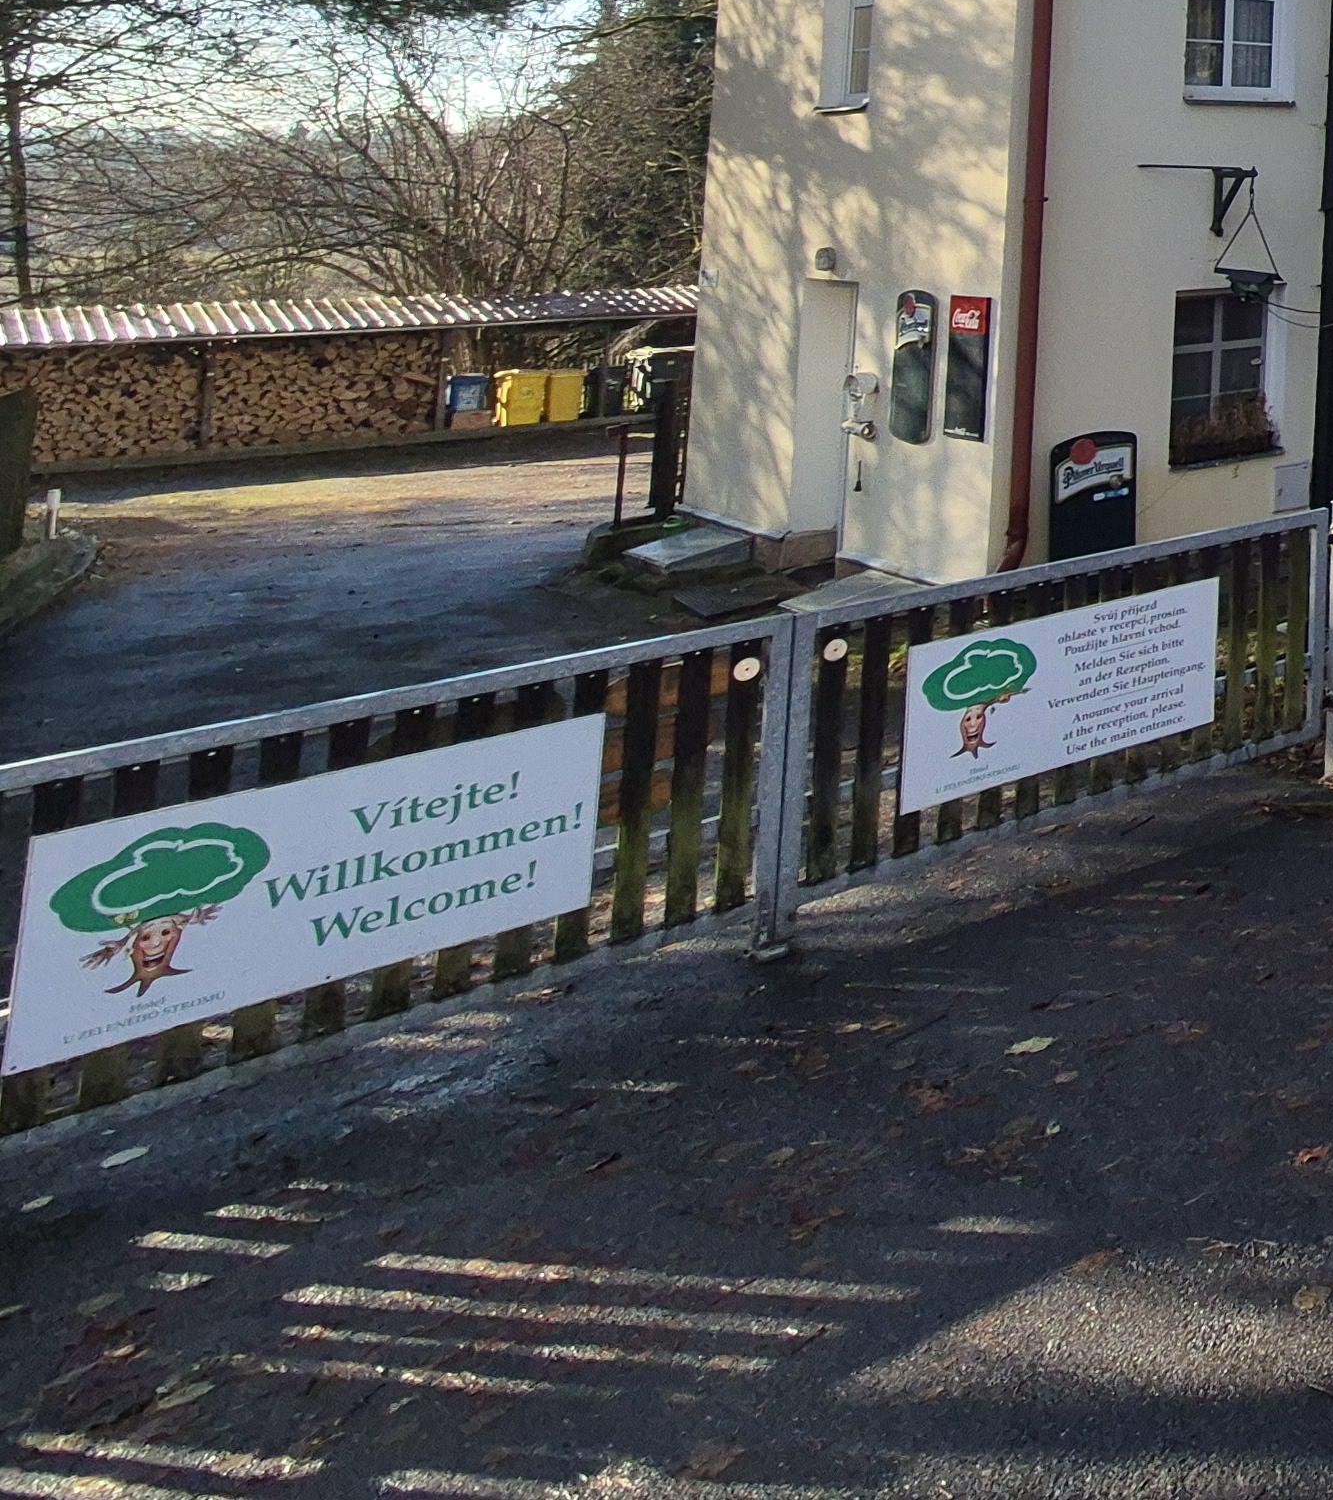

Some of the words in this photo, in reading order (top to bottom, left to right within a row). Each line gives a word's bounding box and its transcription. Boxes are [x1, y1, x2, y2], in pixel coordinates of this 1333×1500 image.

[1094, 612, 1118, 624] Svůj
[1120, 600, 1158, 619] příjezd
[1057, 627, 1097, 645] ohlaste
[1100, 626, 1107, 634] v
[1064, 639, 1109, 657] Použijte
[1111, 628, 1146, 645] hlavní
[1148, 619, 1182, 635] vchod.
[1074, 656, 1116, 673] Melden
[1118, 651, 1136, 662] Sie
[1138, 644, 1159, 657] sich
[1161, 637, 1185, 651] bitte
[1048, 685, 1110, 709] Verwenden
[1112, 680, 1130, 693] Sie
[1131, 661, 1207, 688] Haupteingang.
[1078, 676, 1092, 687] an
[1094, 670, 1113, 683] der
[1115, 657, 1171, 677] Rezeption.
[1062, 731, 1074, 741] at
[1076, 725, 1094, 737] the
[1095, 710, 1149, 731] reception,
[1151, 700, 1187, 718] please.
[1072, 703, 1122, 724] Anounce
[1123, 698, 1149, 713] your
[1150, 684, 1184, 702] arrival
[1066, 743, 1087, 756] Use
[1090, 737, 1108, 748] the
[1110, 728, 1137, 743] main
[1139, 714, 1186, 735] entrance.
[350, 771, 520, 836] Vítejte!
[263, 801, 584, 909] Willkommen!
[309, 860, 538, 947] Welcome!
